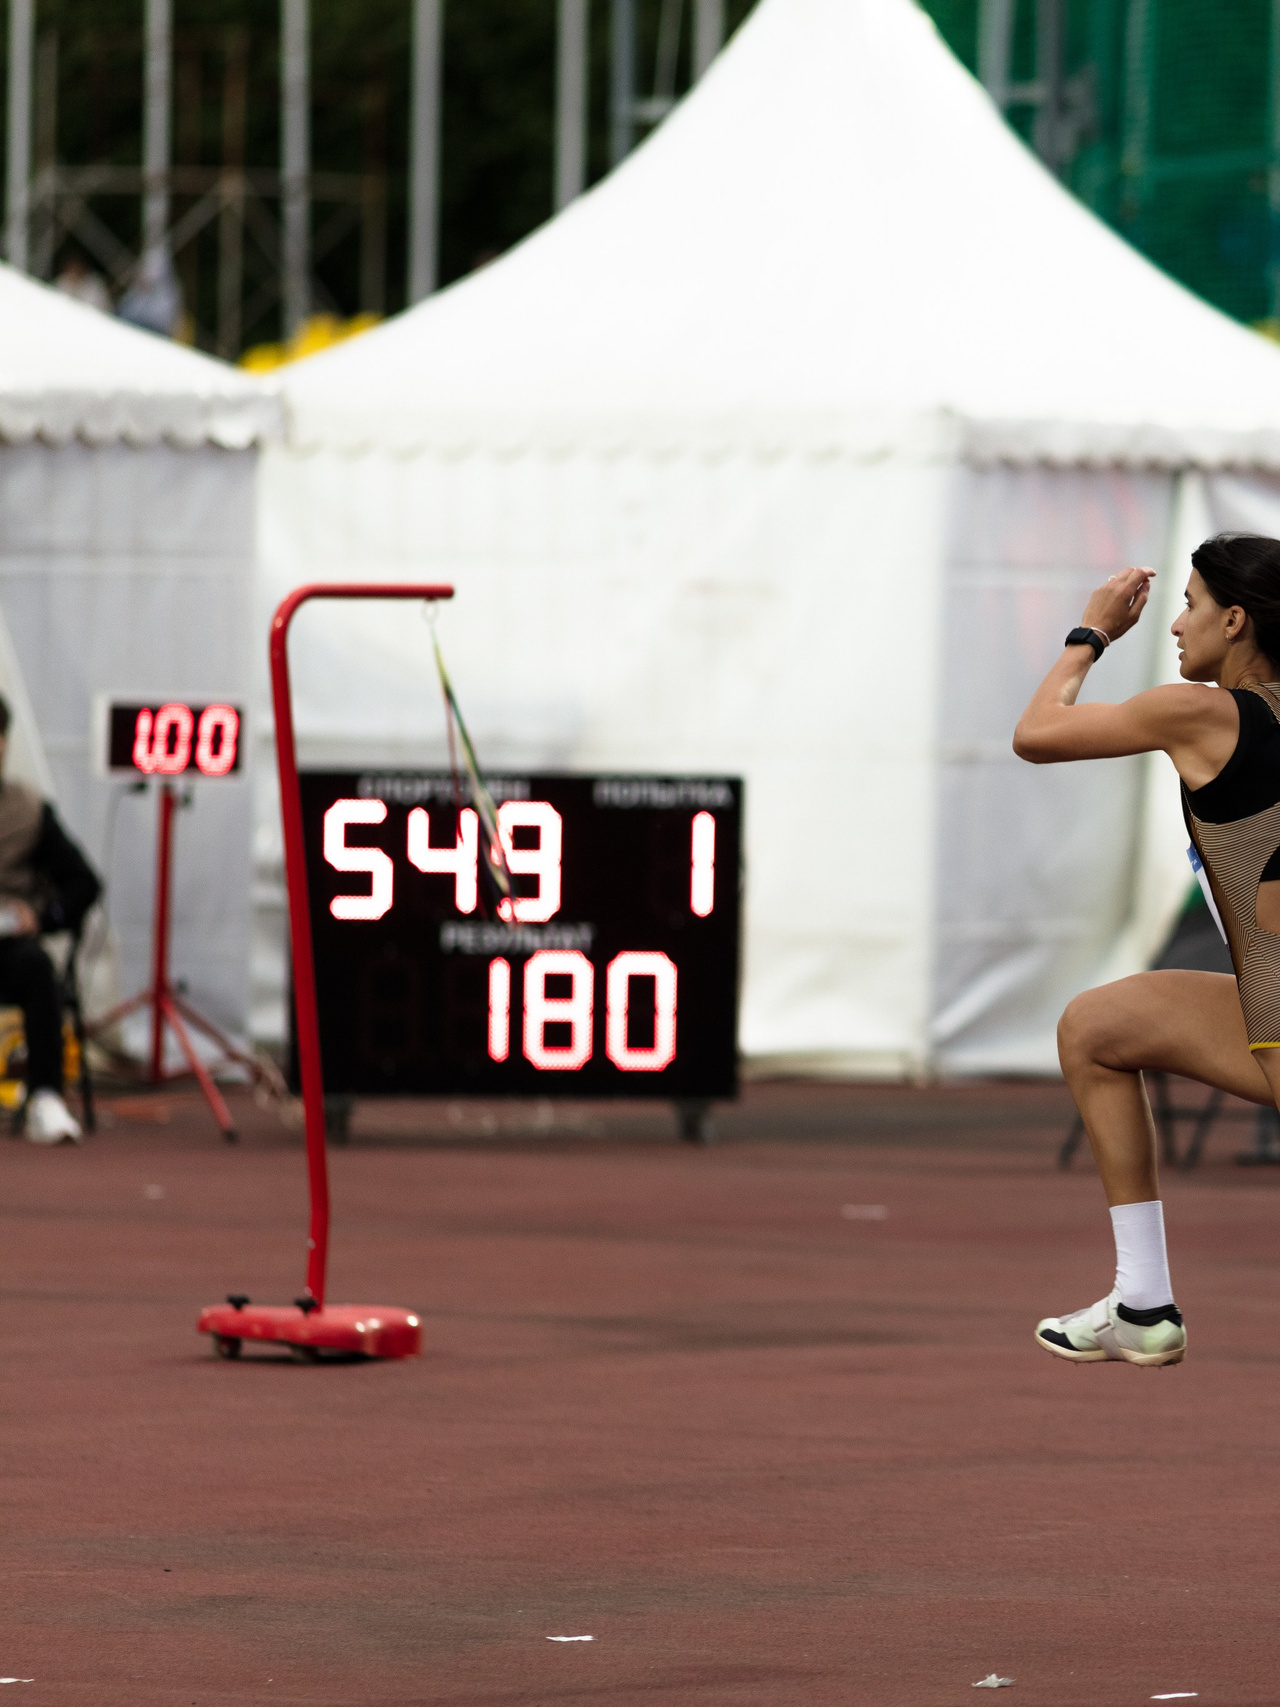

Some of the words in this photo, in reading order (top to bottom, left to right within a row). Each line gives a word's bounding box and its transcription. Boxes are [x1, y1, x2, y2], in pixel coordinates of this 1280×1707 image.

[324, 799, 562, 922] 549
[690, 811, 715, 917] 1
[488, 950, 677, 1071] 180
